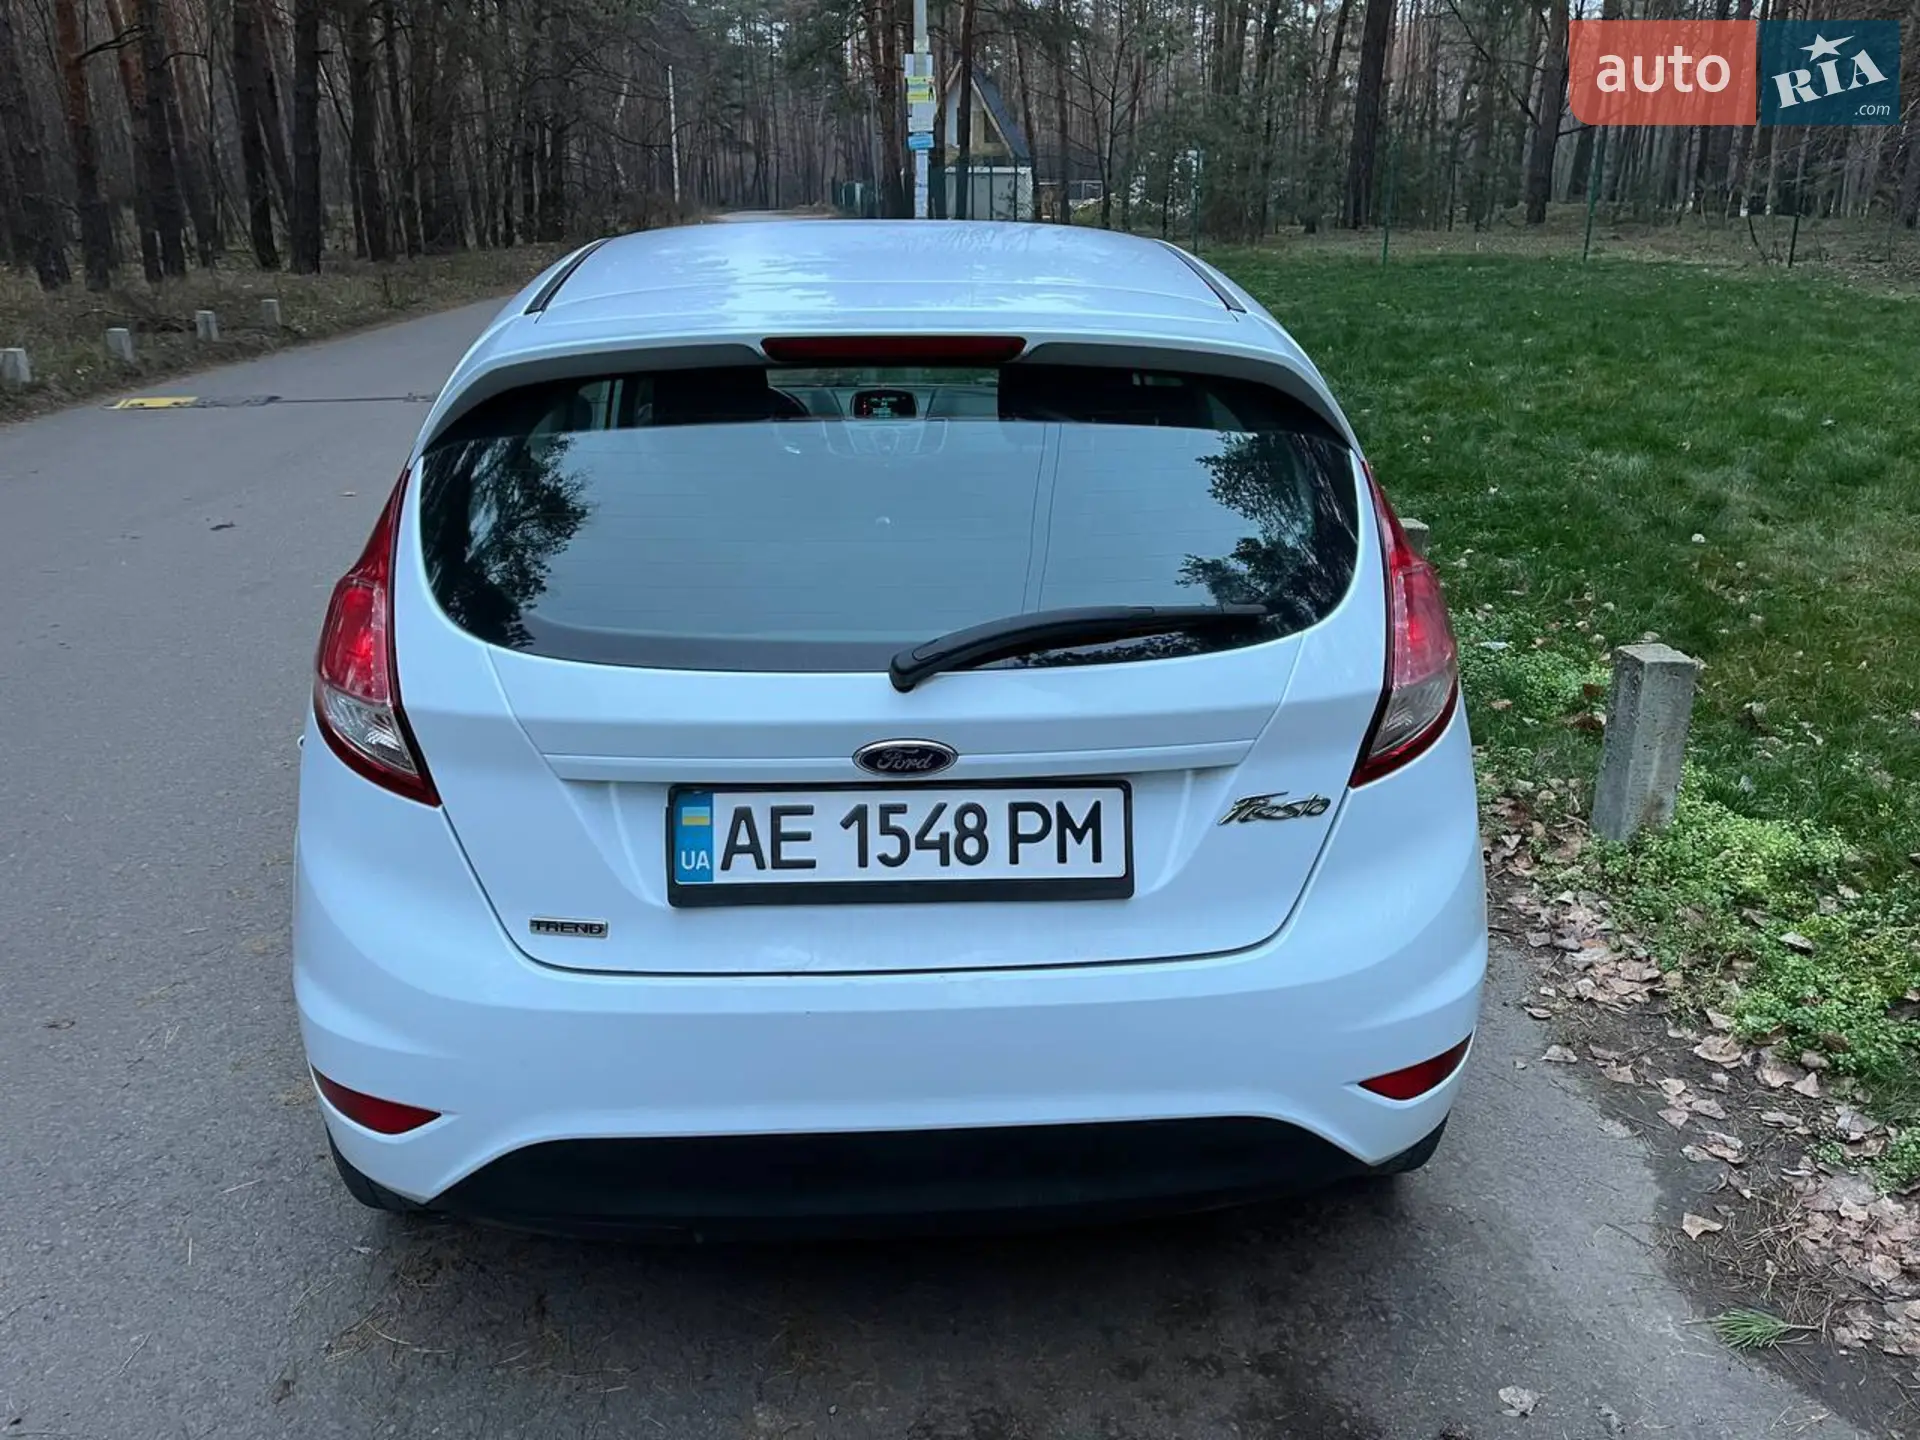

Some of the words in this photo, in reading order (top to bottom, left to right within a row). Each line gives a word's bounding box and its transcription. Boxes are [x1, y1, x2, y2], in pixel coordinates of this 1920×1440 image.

[877, 748, 934, 770] Ford
[720, 804, 816, 871] AE
[839, 802, 989, 868] 1548
[1008, 800, 1102, 865] PM
[681, 850, 711, 870] UA
[531, 920, 603, 934] TREND
